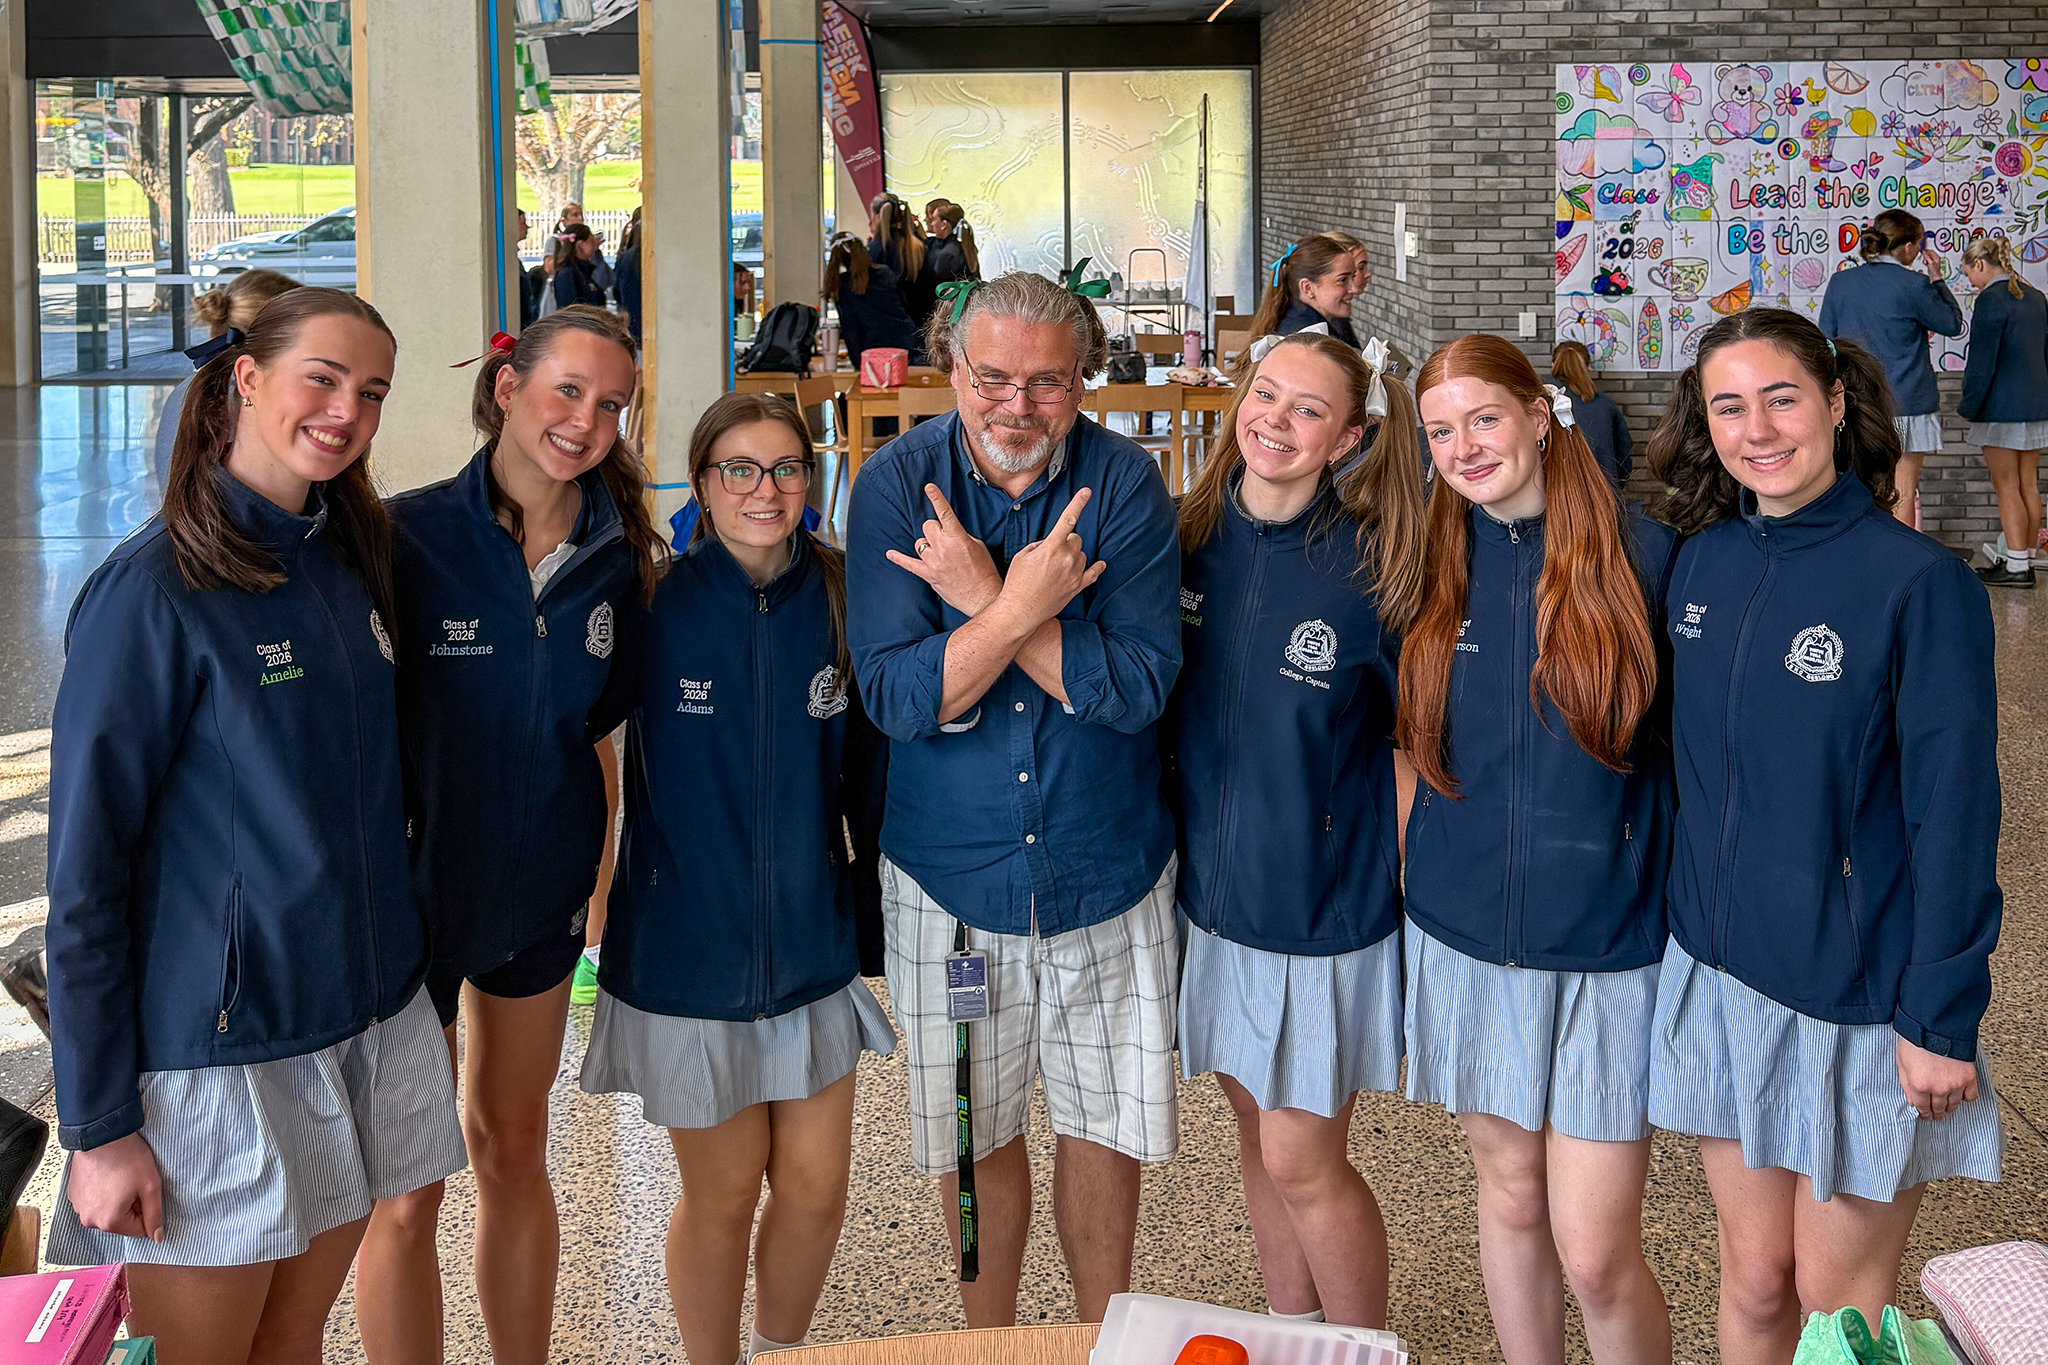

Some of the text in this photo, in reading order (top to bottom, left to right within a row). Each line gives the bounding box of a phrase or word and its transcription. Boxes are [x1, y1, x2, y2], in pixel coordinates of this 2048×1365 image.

[1598, 183, 1660, 204] Class
[1730, 176, 1995, 218] Lead the Change
[1619, 209, 1642, 234] of
[1728, 224, 1766, 255] Be
[1772, 222, 1829, 255] the
[1603, 237, 1664, 260] 2026
[443, 619, 480, 630] Class of
[1181, 610, 1203, 627] Leod
[1462, 619, 1472, 628] of
[1683, 612, 1702, 624] 2026
[447, 630, 476, 641] 2026
[1674, 623, 1702, 639] Wright
[256, 639, 292, 656] Class of
[429, 643, 494, 656] Johnstone
[1454, 642, 1480, 653] rson
[265, 651, 293, 667] 2026
[259, 665, 305, 686] Amelie
[1279, 667, 1331, 690] College Captain
[679, 678, 713, 690] Class of
[683, 690, 708, 700] 2026
[676, 701, 714, 715] Adams
